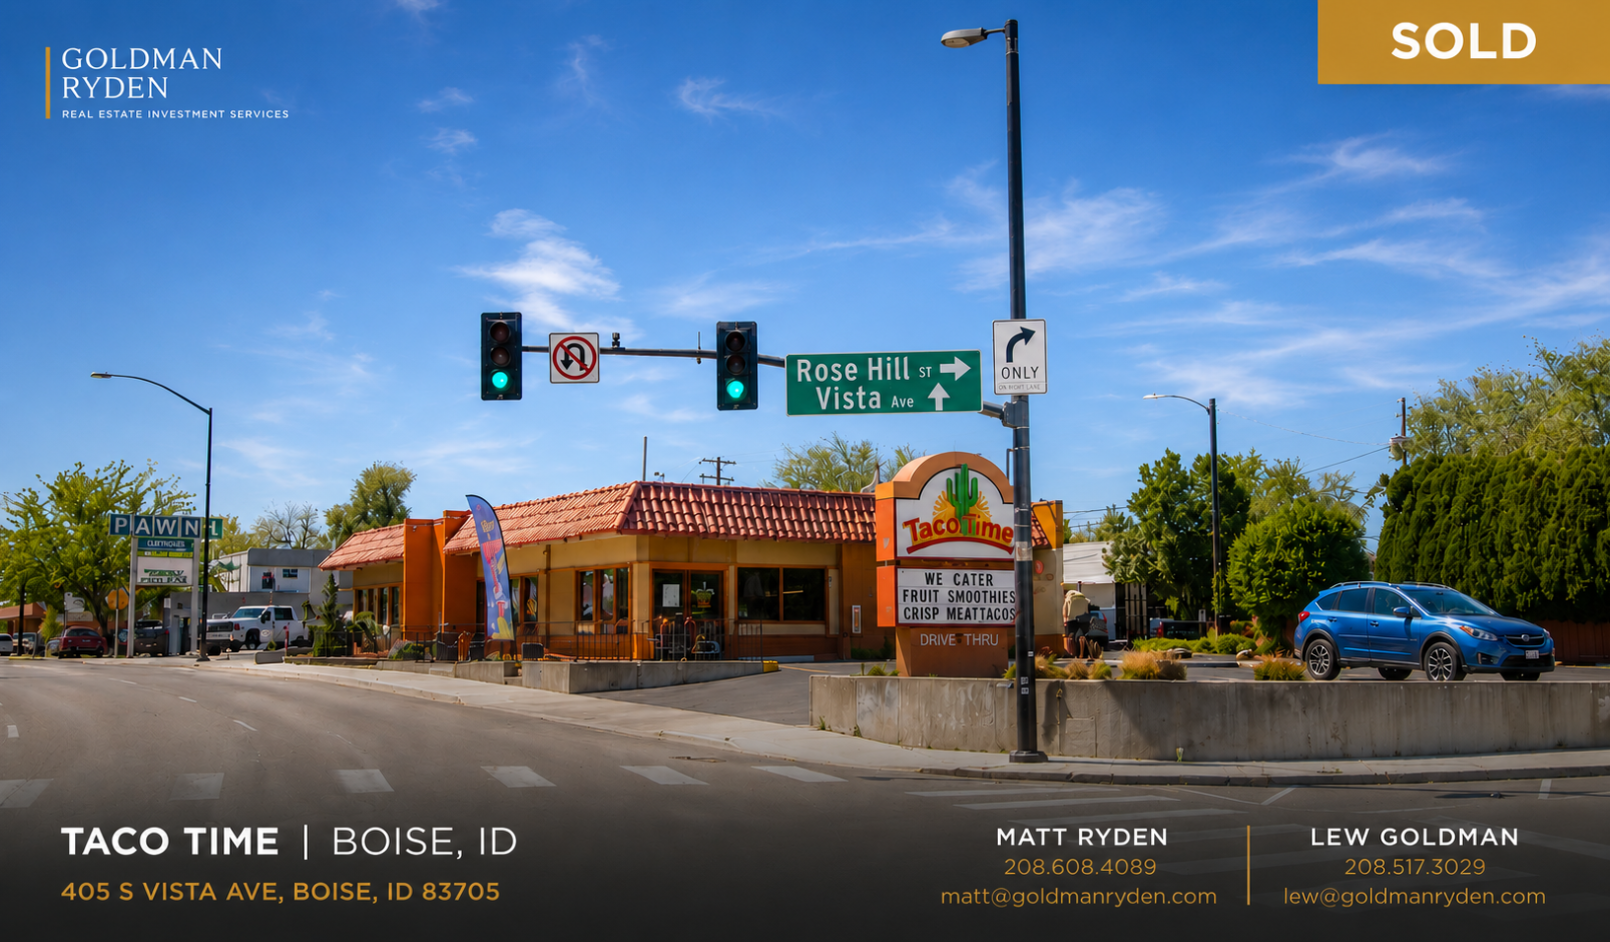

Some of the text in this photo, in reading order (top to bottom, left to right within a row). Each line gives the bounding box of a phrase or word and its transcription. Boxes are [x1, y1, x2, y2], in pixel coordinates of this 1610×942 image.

[796, 356, 932, 382] Rose Hill ST
[1001, 366, 1039, 380] ONLY
[815, 385, 914, 410] Vista Ave
[114, 517, 199, 536] PAWN
[902, 513, 1014, 544] Taco Time
[924, 572, 994, 587] WE CATER
[902, 589, 1016, 605] FRUIT SMOOTHIES
[903, 606, 940, 621] CRISP
[920, 633, 999, 647] DRIVE THRU
